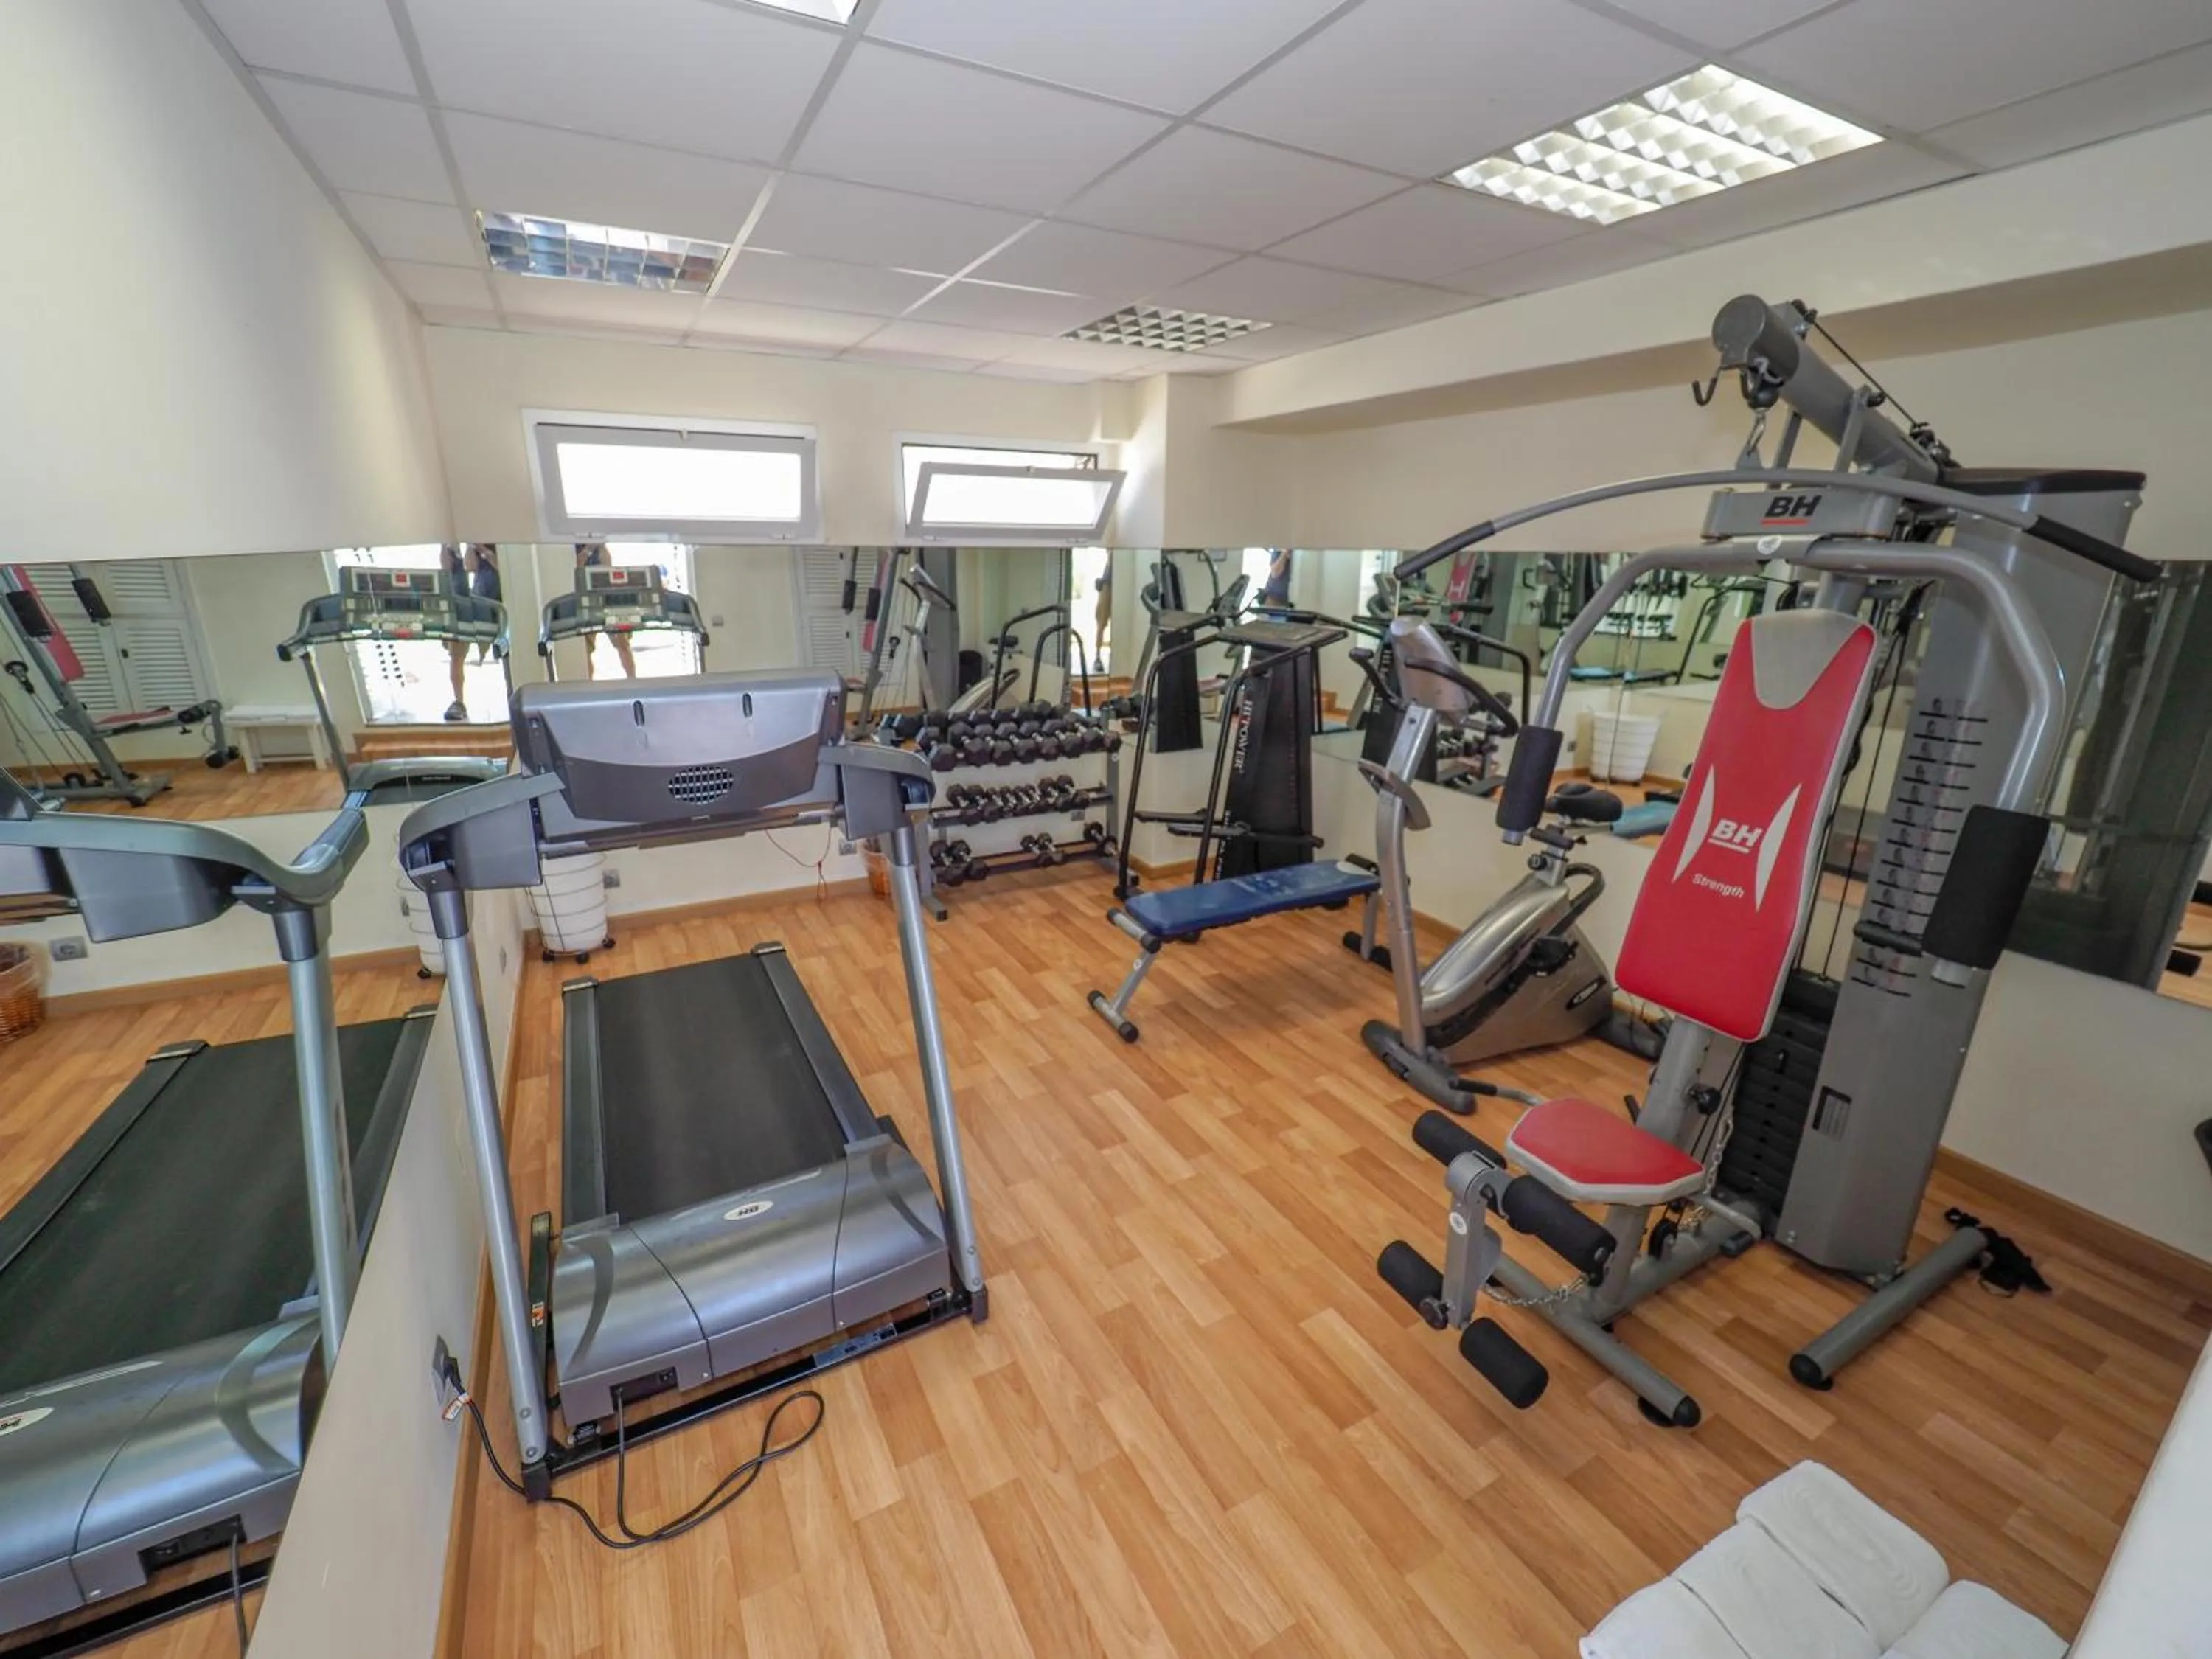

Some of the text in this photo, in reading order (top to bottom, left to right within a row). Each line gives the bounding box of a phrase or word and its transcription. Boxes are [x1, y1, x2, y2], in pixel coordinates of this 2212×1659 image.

[1764, 495, 1822, 518] BH
[1711, 818, 1763, 847] BH
[1691, 872, 1745, 898] Strength
